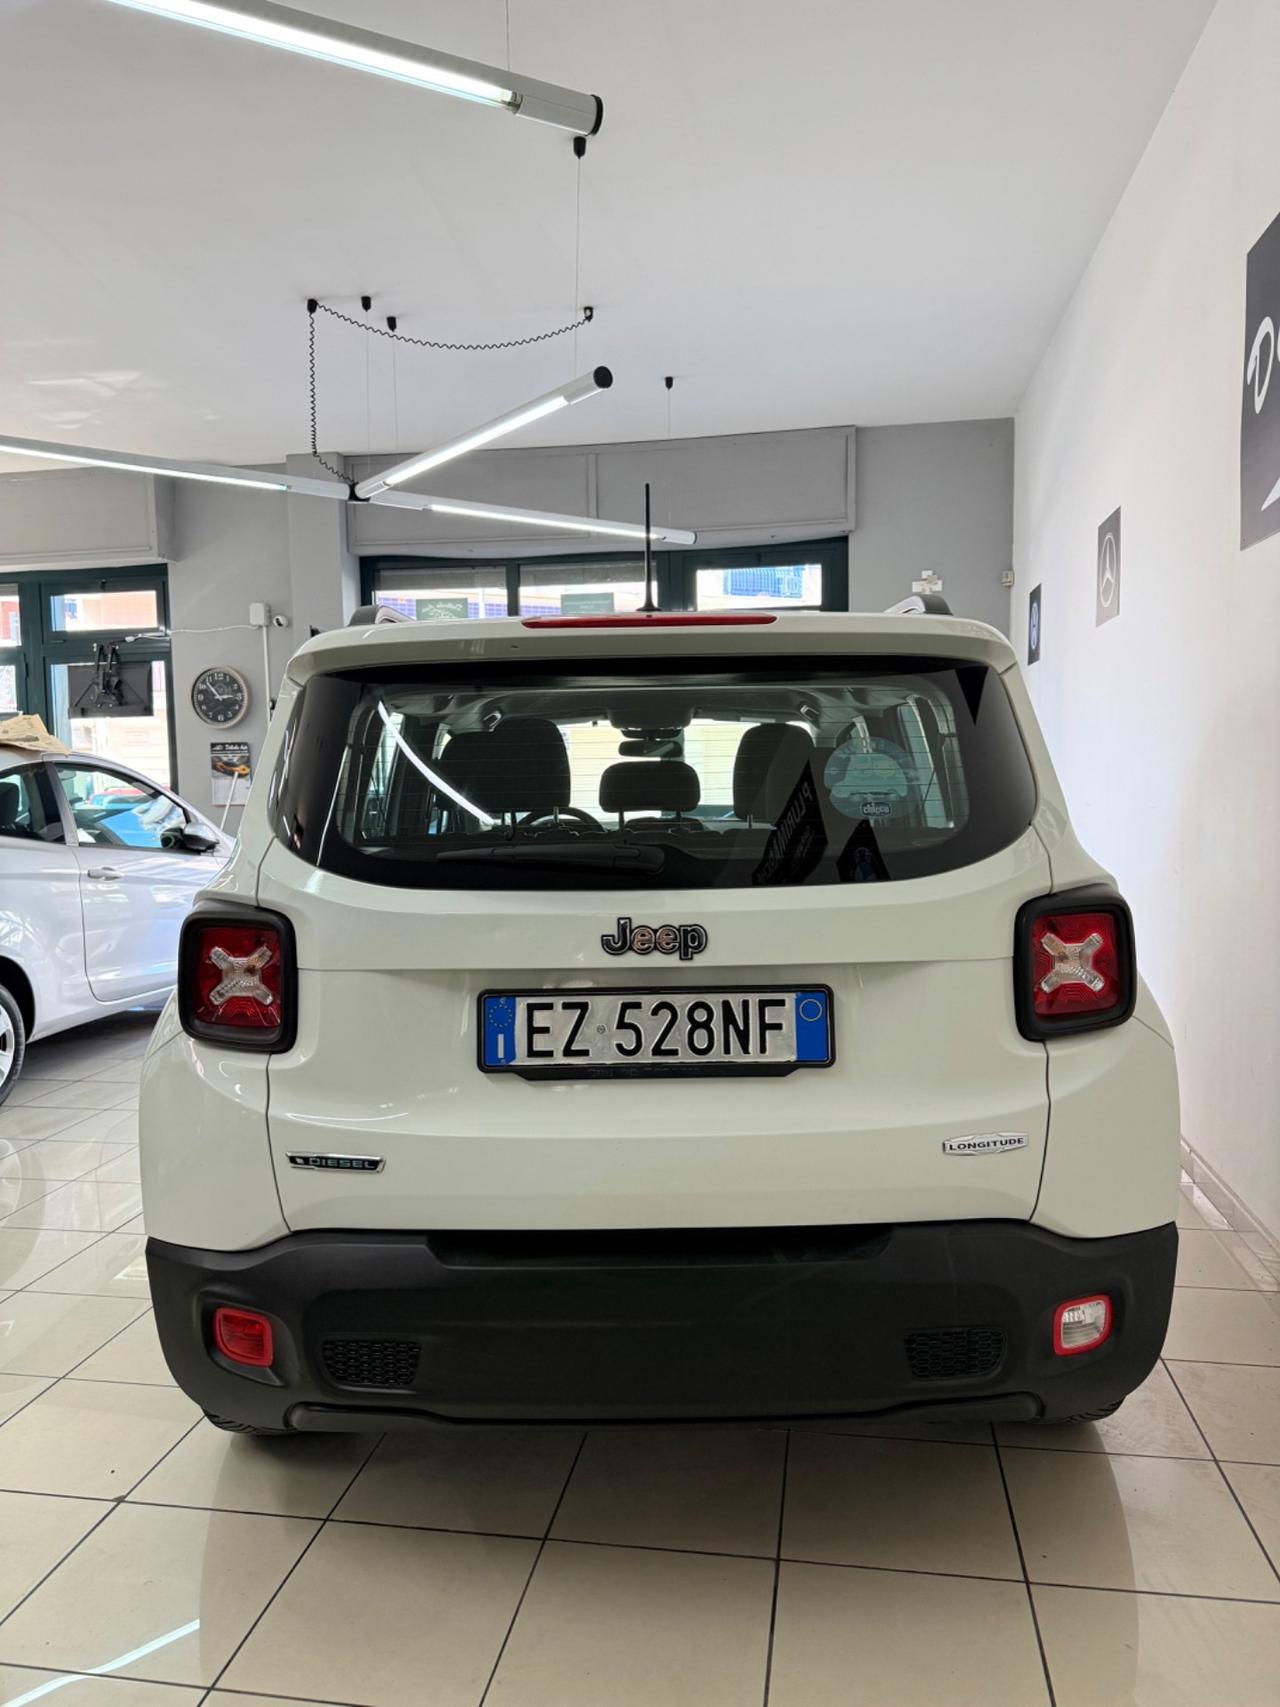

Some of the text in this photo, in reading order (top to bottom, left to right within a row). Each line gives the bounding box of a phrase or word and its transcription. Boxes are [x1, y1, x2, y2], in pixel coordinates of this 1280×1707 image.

[601, 917, 708, 961] Jeep
[526, 998, 786, 1058] EZ 528NF
[949, 1137, 1024, 1151] LONGITUDE
[308, 1157, 376, 1169] DIESEL
